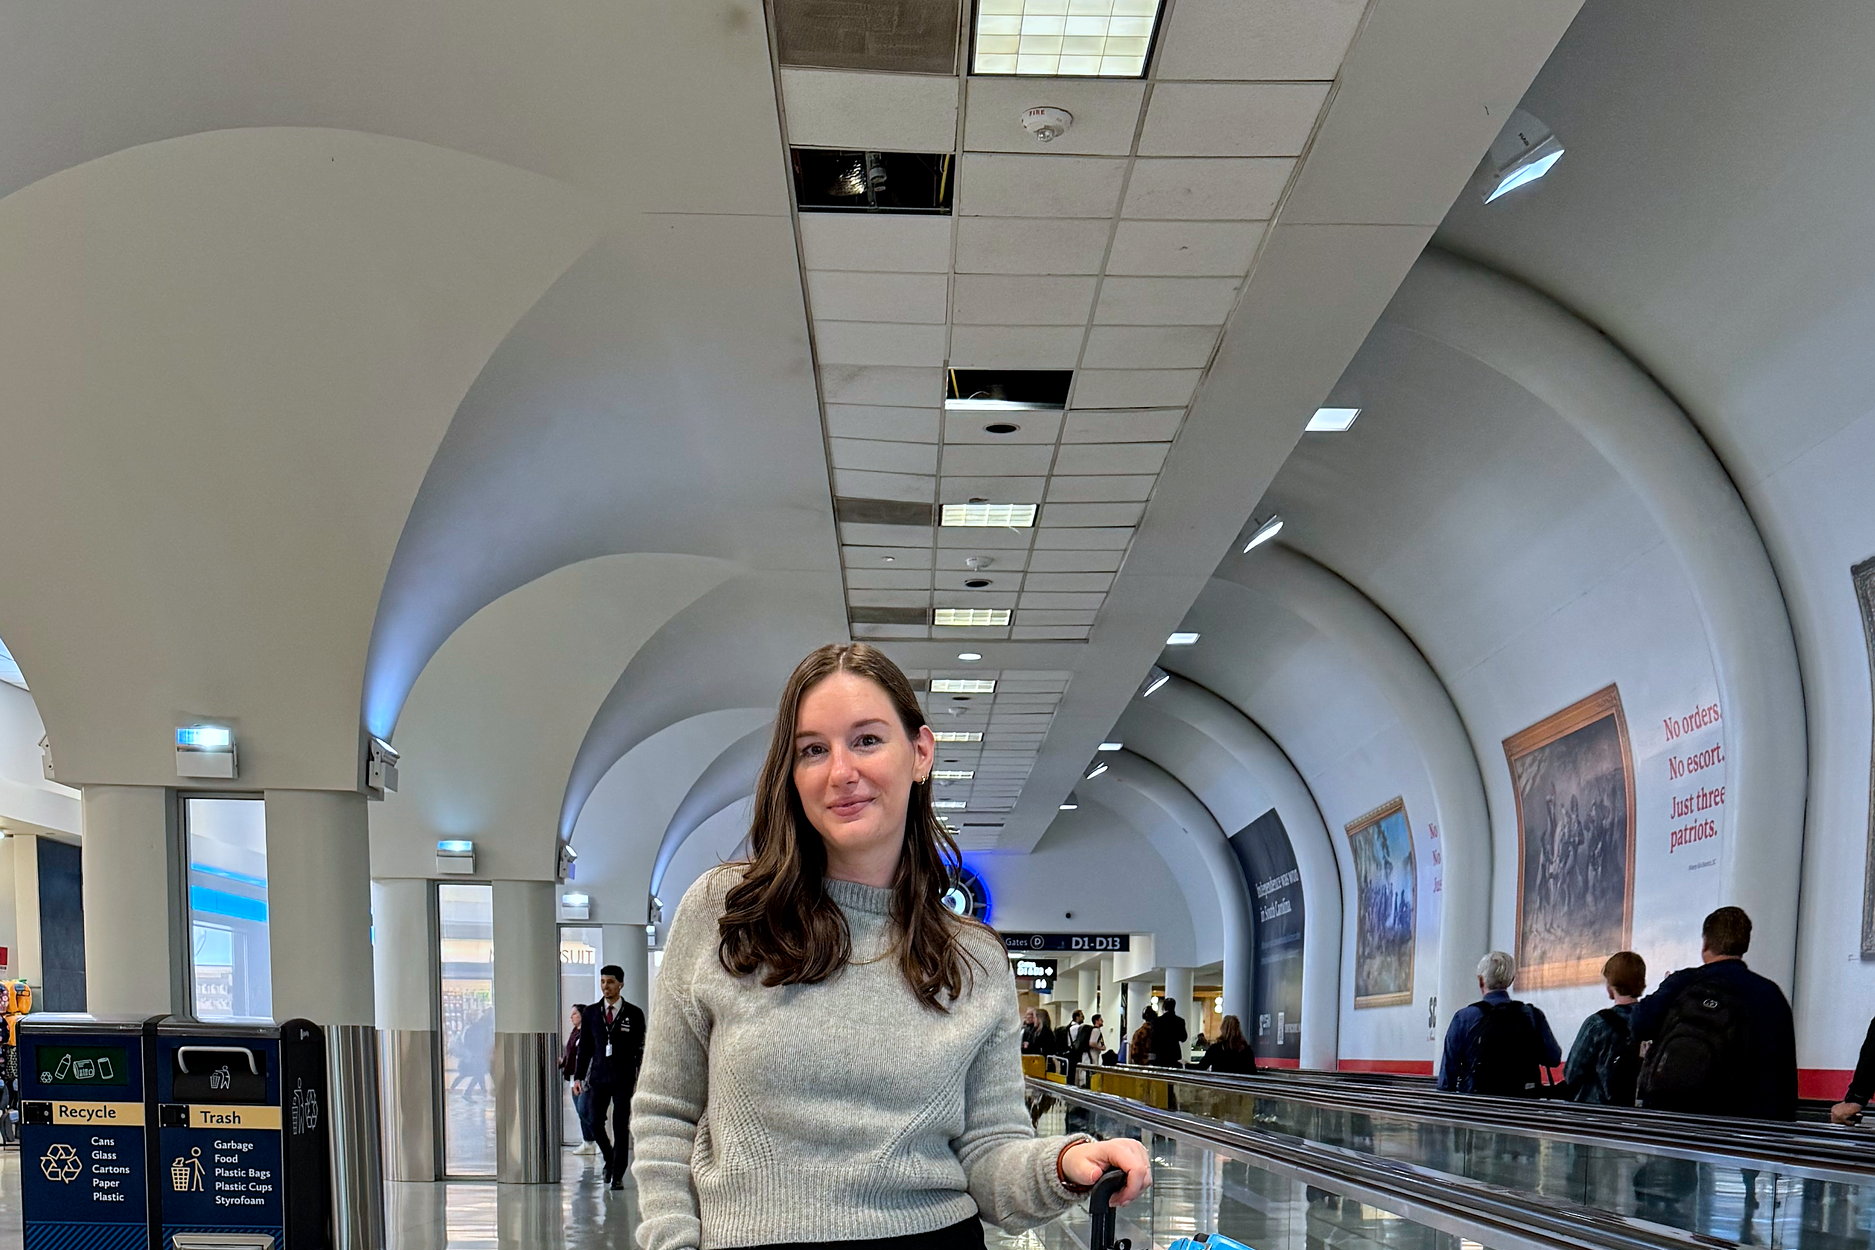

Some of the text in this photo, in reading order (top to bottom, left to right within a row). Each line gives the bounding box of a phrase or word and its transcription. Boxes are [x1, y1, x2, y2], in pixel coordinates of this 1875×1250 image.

[1663, 716, 1681, 742] No
[1668, 741, 1726, 781] No escort.
[1669, 785, 1726, 820] Just three
[1669, 818, 1718, 854] patriots.
[1005, 937, 1028, 946] Gates
[1071, 936, 1121, 950] D1-D13
[560, 949, 593, 964] SUIT
[58, 1104, 117, 1122] Recycle
[199, 1110, 242, 1125] Trash
[91, 1136, 115, 1146] Cans
[214, 1140, 254, 1152] Garbage
[91, 1150, 117, 1160] Glass
[214, 1154, 239, 1163] Food
[92, 1164, 130, 1174] Cartons
[215, 1167, 271, 1180] Plastic Bags
[92, 1178, 120, 1189] Paper
[215, 1181, 273, 1194] Plastic Cups
[93, 1192, 125, 1201] Plastic
[215, 1195, 265, 1207] Styrofoam
